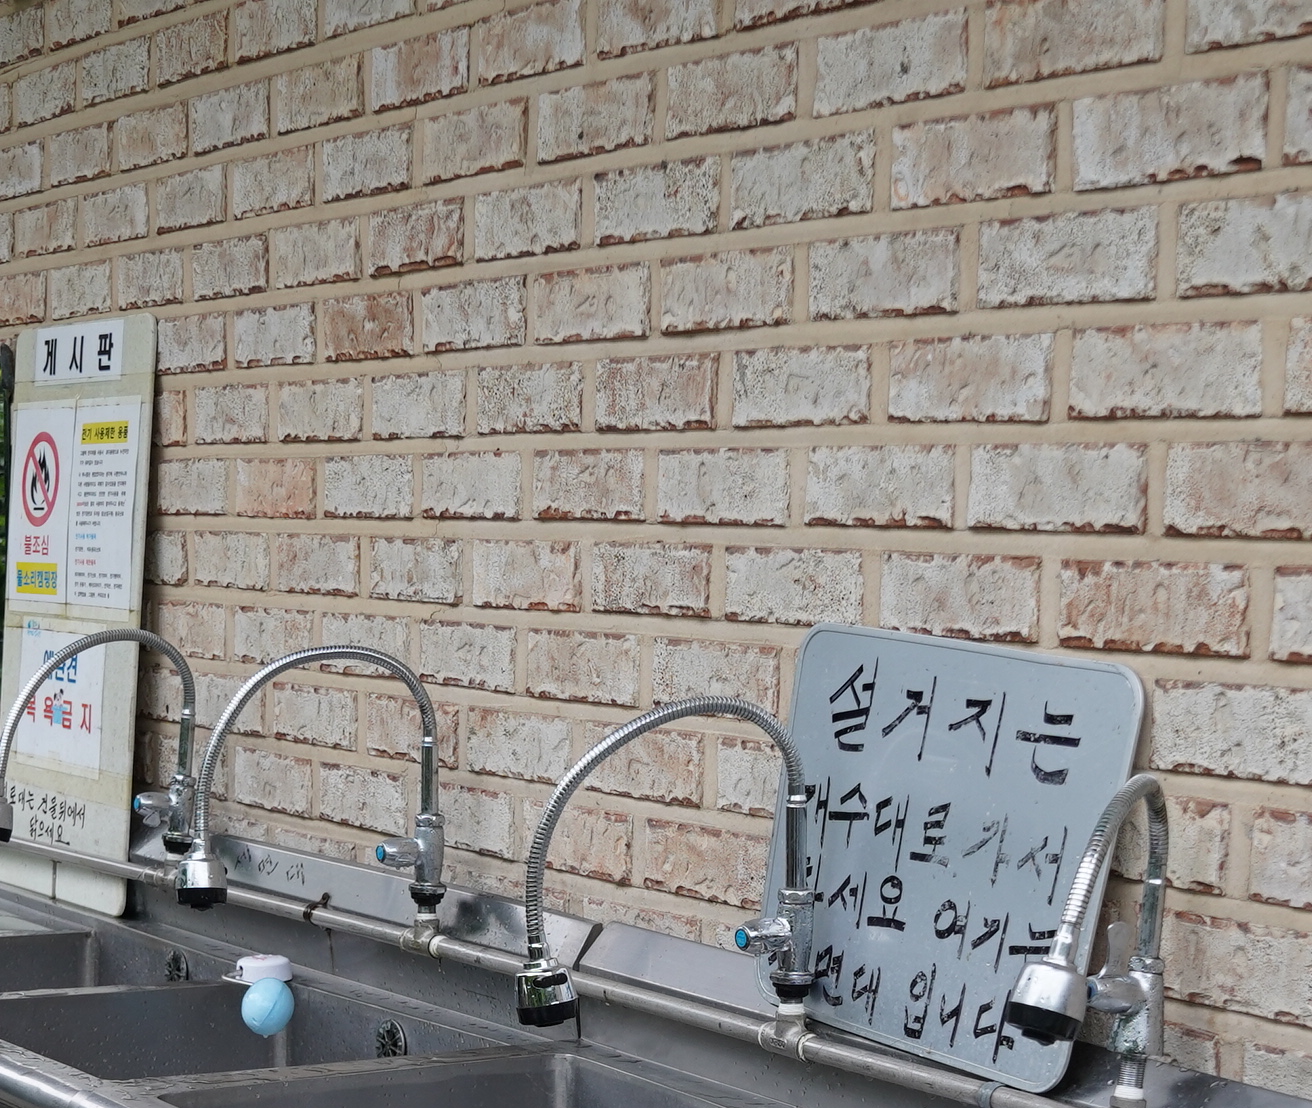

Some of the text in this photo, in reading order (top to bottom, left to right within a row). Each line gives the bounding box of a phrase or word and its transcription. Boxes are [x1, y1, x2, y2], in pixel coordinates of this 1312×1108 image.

[43, 332, 114, 376] 게시판
[24, 535, 51, 556] 불조심
[16, 569, 58, 589] 물소리캠핑장
[829, 656, 1082, 786] 설거지는
[5, 781, 35, 812] 로대는
[903, 962, 1016, 1065] 입니다
